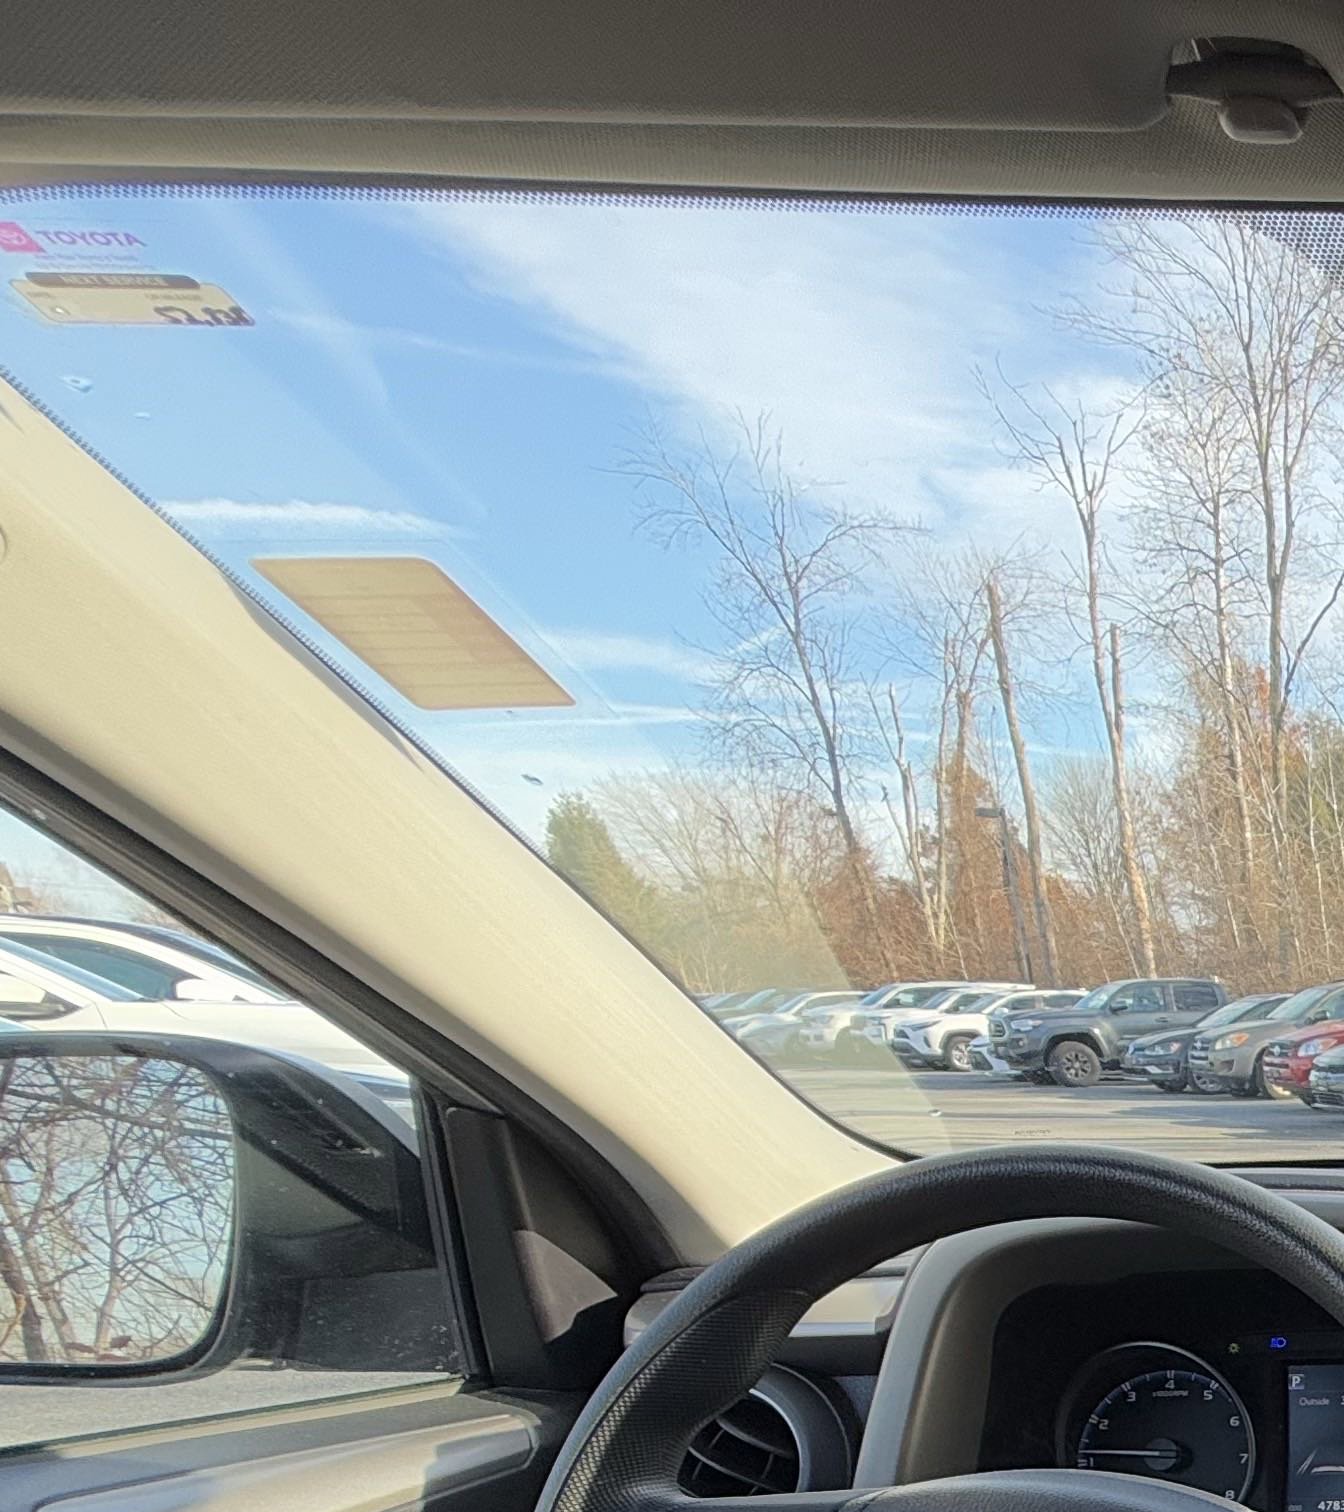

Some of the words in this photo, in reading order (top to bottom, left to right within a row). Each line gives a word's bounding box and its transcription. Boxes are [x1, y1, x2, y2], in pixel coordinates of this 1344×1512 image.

[35, 230, 148, 247] TOYOTA
[1165, 1379, 1175, 1389] 4
[1291, 1375, 1301, 1388] P
[1127, 1391, 1136, 1402] 3
[1203, 1390, 1213, 1400] 5
[1299, 1397, 1330, 1406] Outside
[1099, 1419, 1109, 1430] 2
[1229, 1416, 1240, 1427] 6
[1239, 1454, 1249, 1465] 7
[1225, 1490, 1235, 1500] 8
